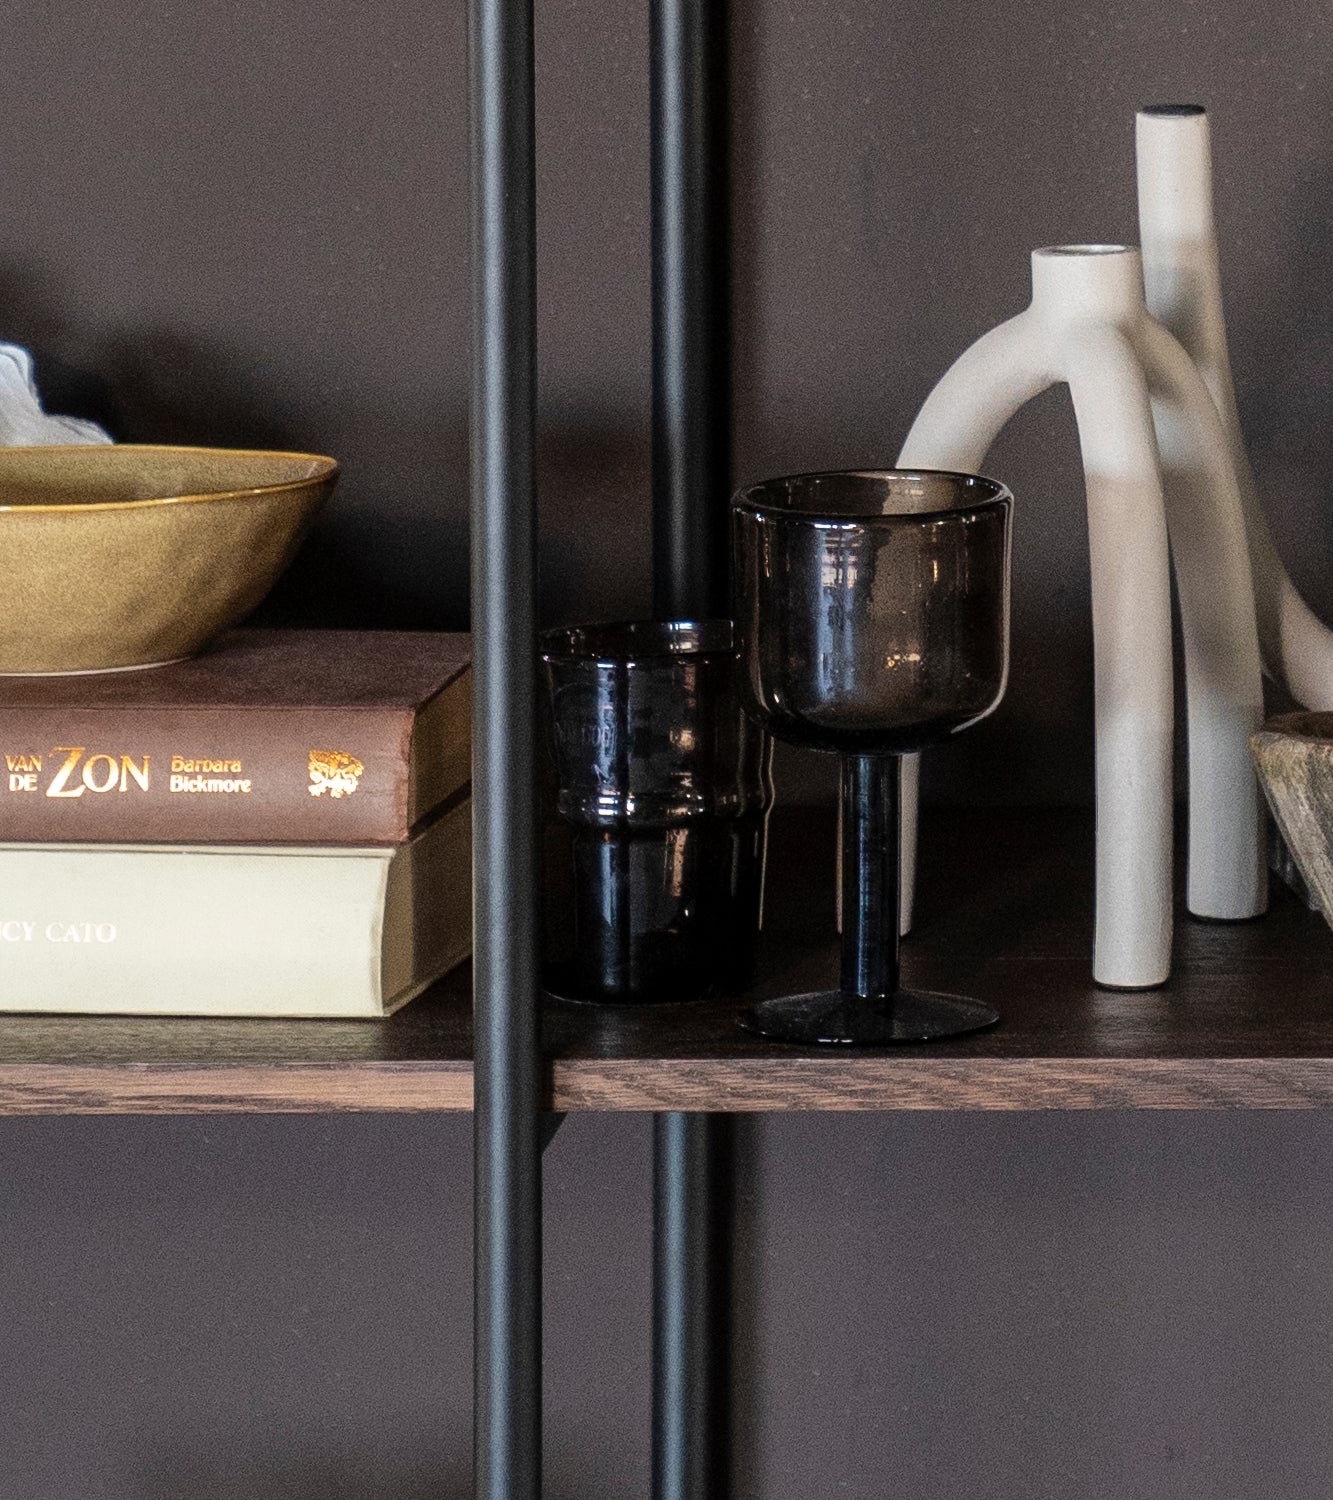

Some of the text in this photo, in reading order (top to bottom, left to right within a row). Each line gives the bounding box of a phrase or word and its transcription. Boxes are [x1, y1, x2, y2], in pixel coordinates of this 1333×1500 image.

[4, 755, 43, 772] VAN
[45, 747, 151, 798] ZON
[170, 755, 243, 773] Barbara
[9, 773, 39, 792] DE
[169, 774, 252, 794] Bickmore
[45, 921, 117, 943] CATO
